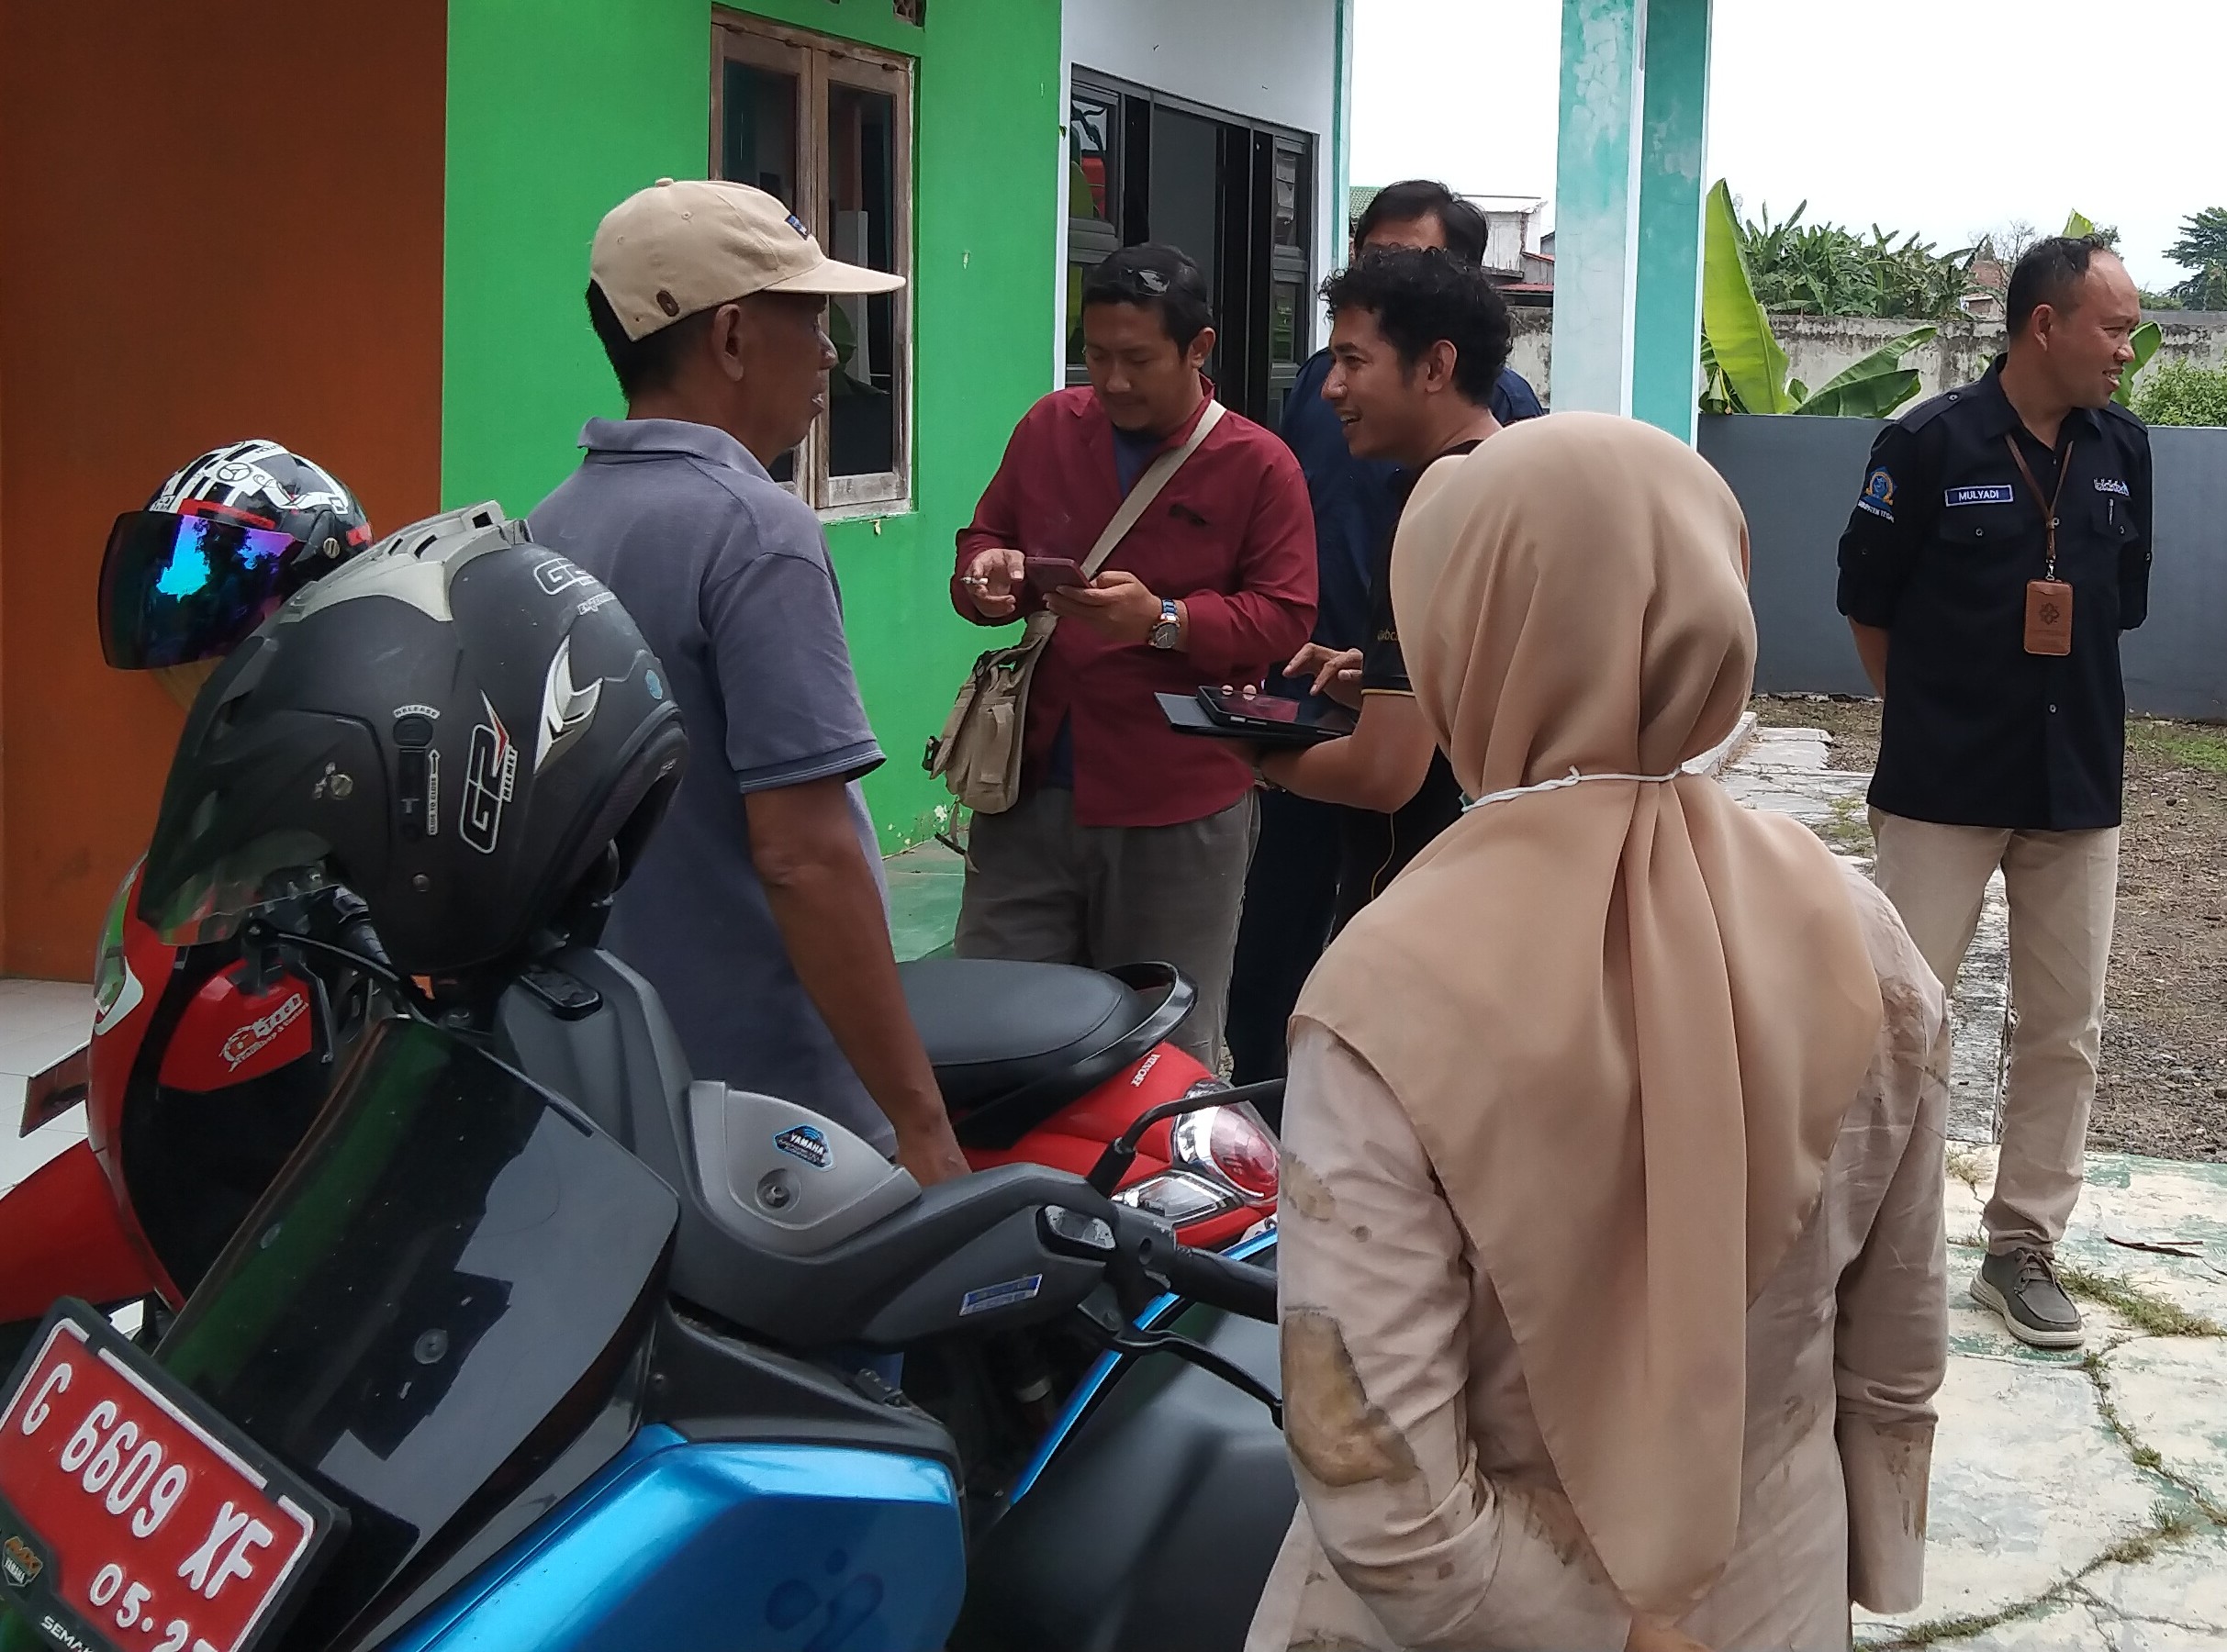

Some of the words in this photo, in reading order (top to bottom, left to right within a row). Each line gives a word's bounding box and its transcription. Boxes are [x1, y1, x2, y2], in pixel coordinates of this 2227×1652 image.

[1958, 489, 1999, 502] MULYADI
[790, 1132, 824, 1155] YAMAHA
[61, 1400, 187, 1538] 6609
[177, 1501, 274, 1599] XF
[40, 1615, 95, 1652] SEMA
